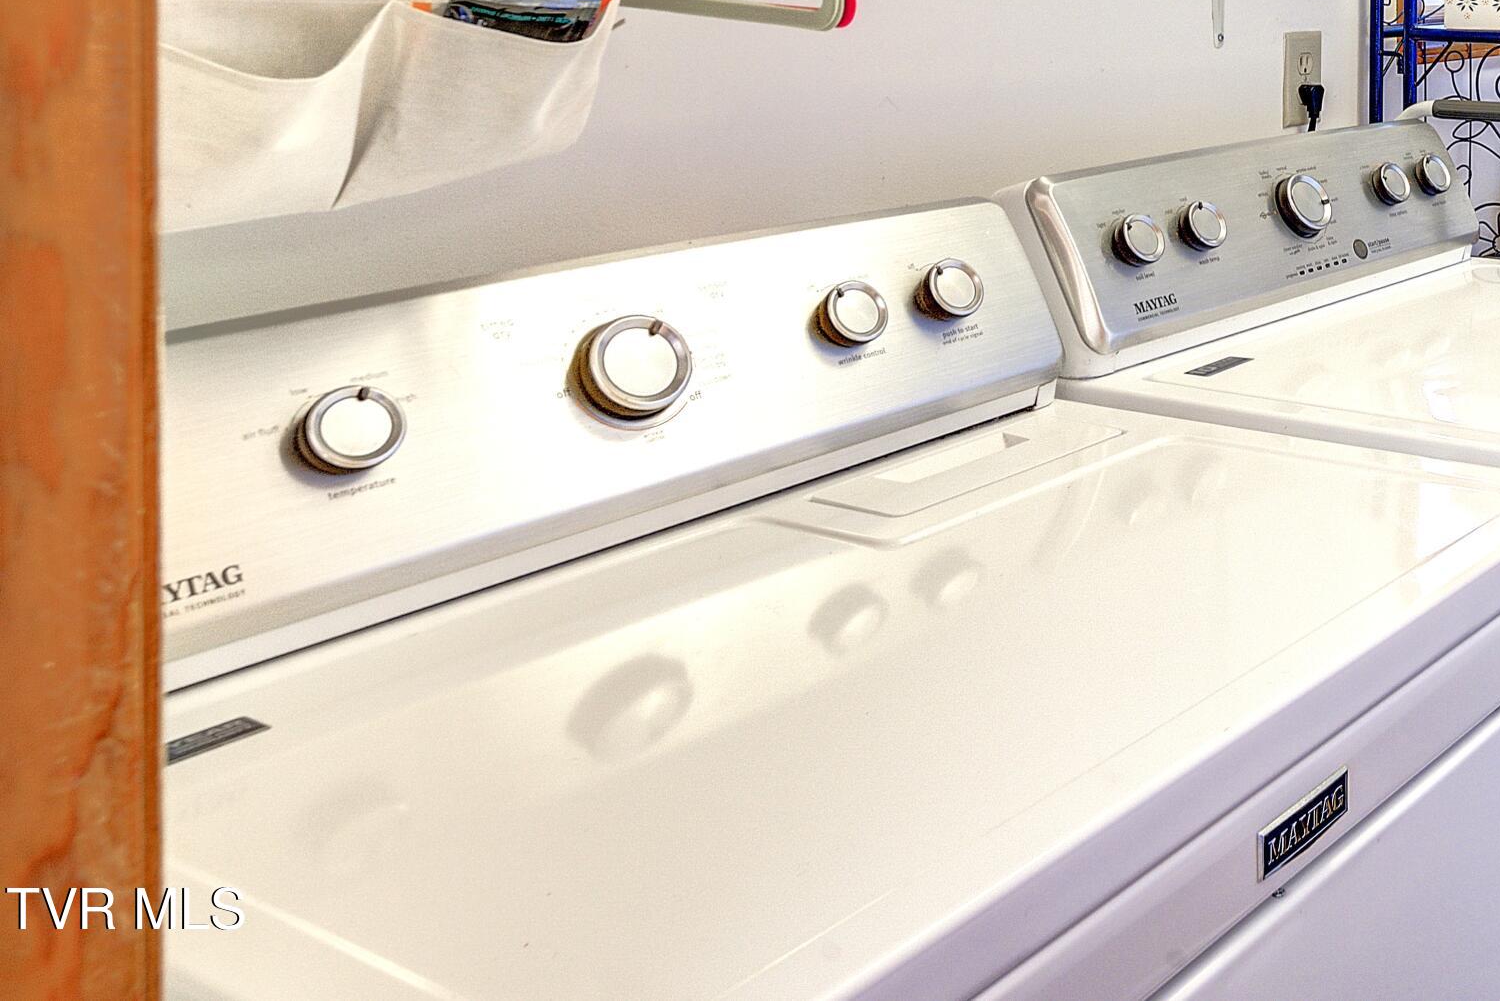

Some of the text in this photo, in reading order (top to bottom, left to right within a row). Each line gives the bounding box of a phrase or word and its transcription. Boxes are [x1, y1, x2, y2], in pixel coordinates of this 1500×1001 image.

[1133, 292, 1178, 316] MAYTAG
[942, 329, 957, 340] push
[965, 324, 980, 333] start
[838, 347, 887, 366] wrinkle control
[689, 389, 704, 402] off
[327, 476, 397, 500] temperature
[161, 563, 245, 604] YTAG
[184, 588, 246, 613] TECHNOLOGY
[1267, 784, 1345, 866] MAYTAG
